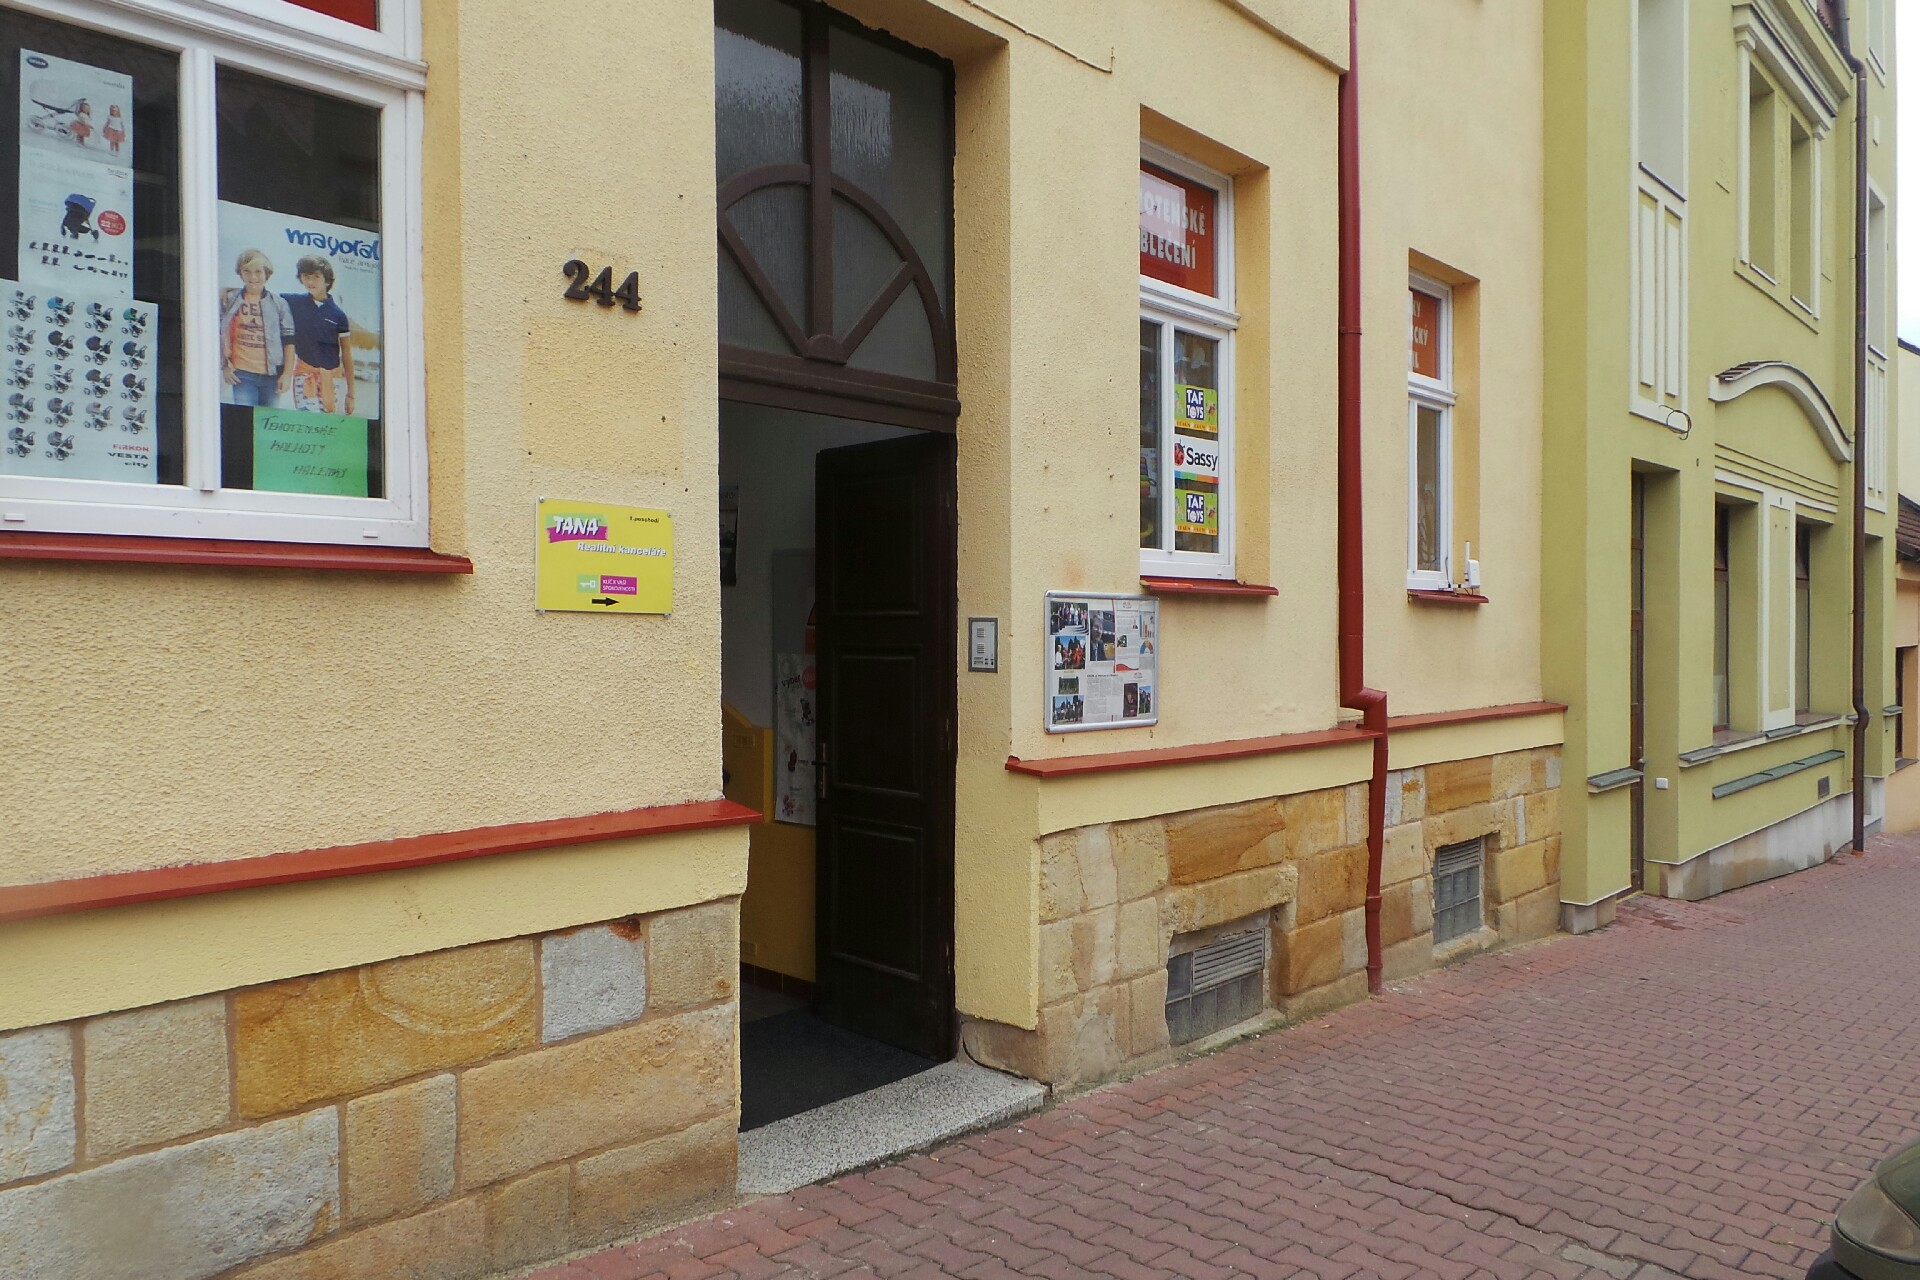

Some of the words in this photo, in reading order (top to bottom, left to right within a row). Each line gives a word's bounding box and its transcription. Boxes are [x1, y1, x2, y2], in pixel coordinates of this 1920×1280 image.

[286, 228, 379, 260] mayoral
[563, 260, 642, 311] 244
[1186, 390, 1204, 405] TAF
[1186, 405, 1204, 419] TOYS
[108, 452, 149, 460] VESTA
[1186, 447, 1218, 471] Sassy
[1187, 494, 1204, 509] TAF
[1187, 509, 1204, 523] TOYS
[553, 515, 599, 535] TANA
